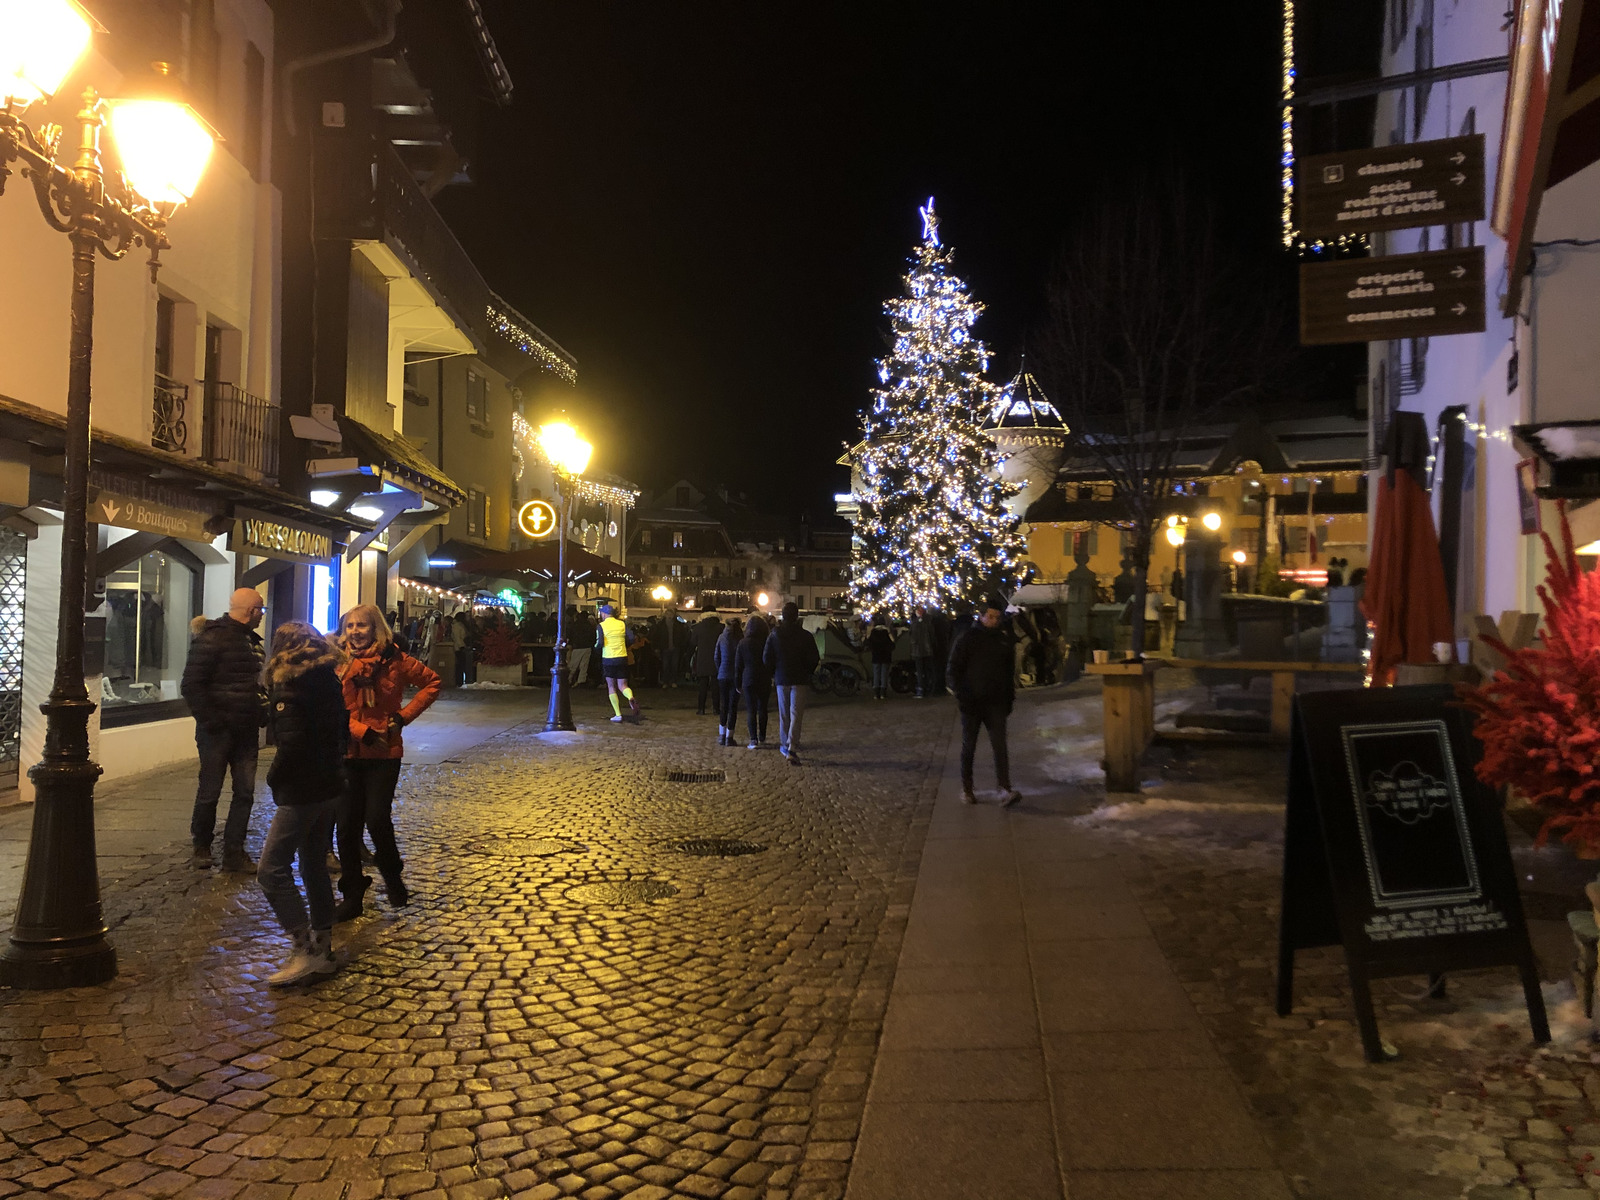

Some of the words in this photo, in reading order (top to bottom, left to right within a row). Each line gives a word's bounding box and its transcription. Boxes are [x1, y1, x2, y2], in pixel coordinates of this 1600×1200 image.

[1357, 157, 1424, 176] chamois
[1344, 189, 1438, 209] rochebrune
[1336, 207, 1379, 222] mont
[1347, 286, 1383, 299] chez
[1386, 281, 1435, 296] maria
[1347, 306, 1436, 323] commerces
[125, 502, 134, 521] 9
[137, 504, 188, 534] Boutiques
[248, 518, 280, 549] YVES
[281, 526, 329, 558] SALOMON
